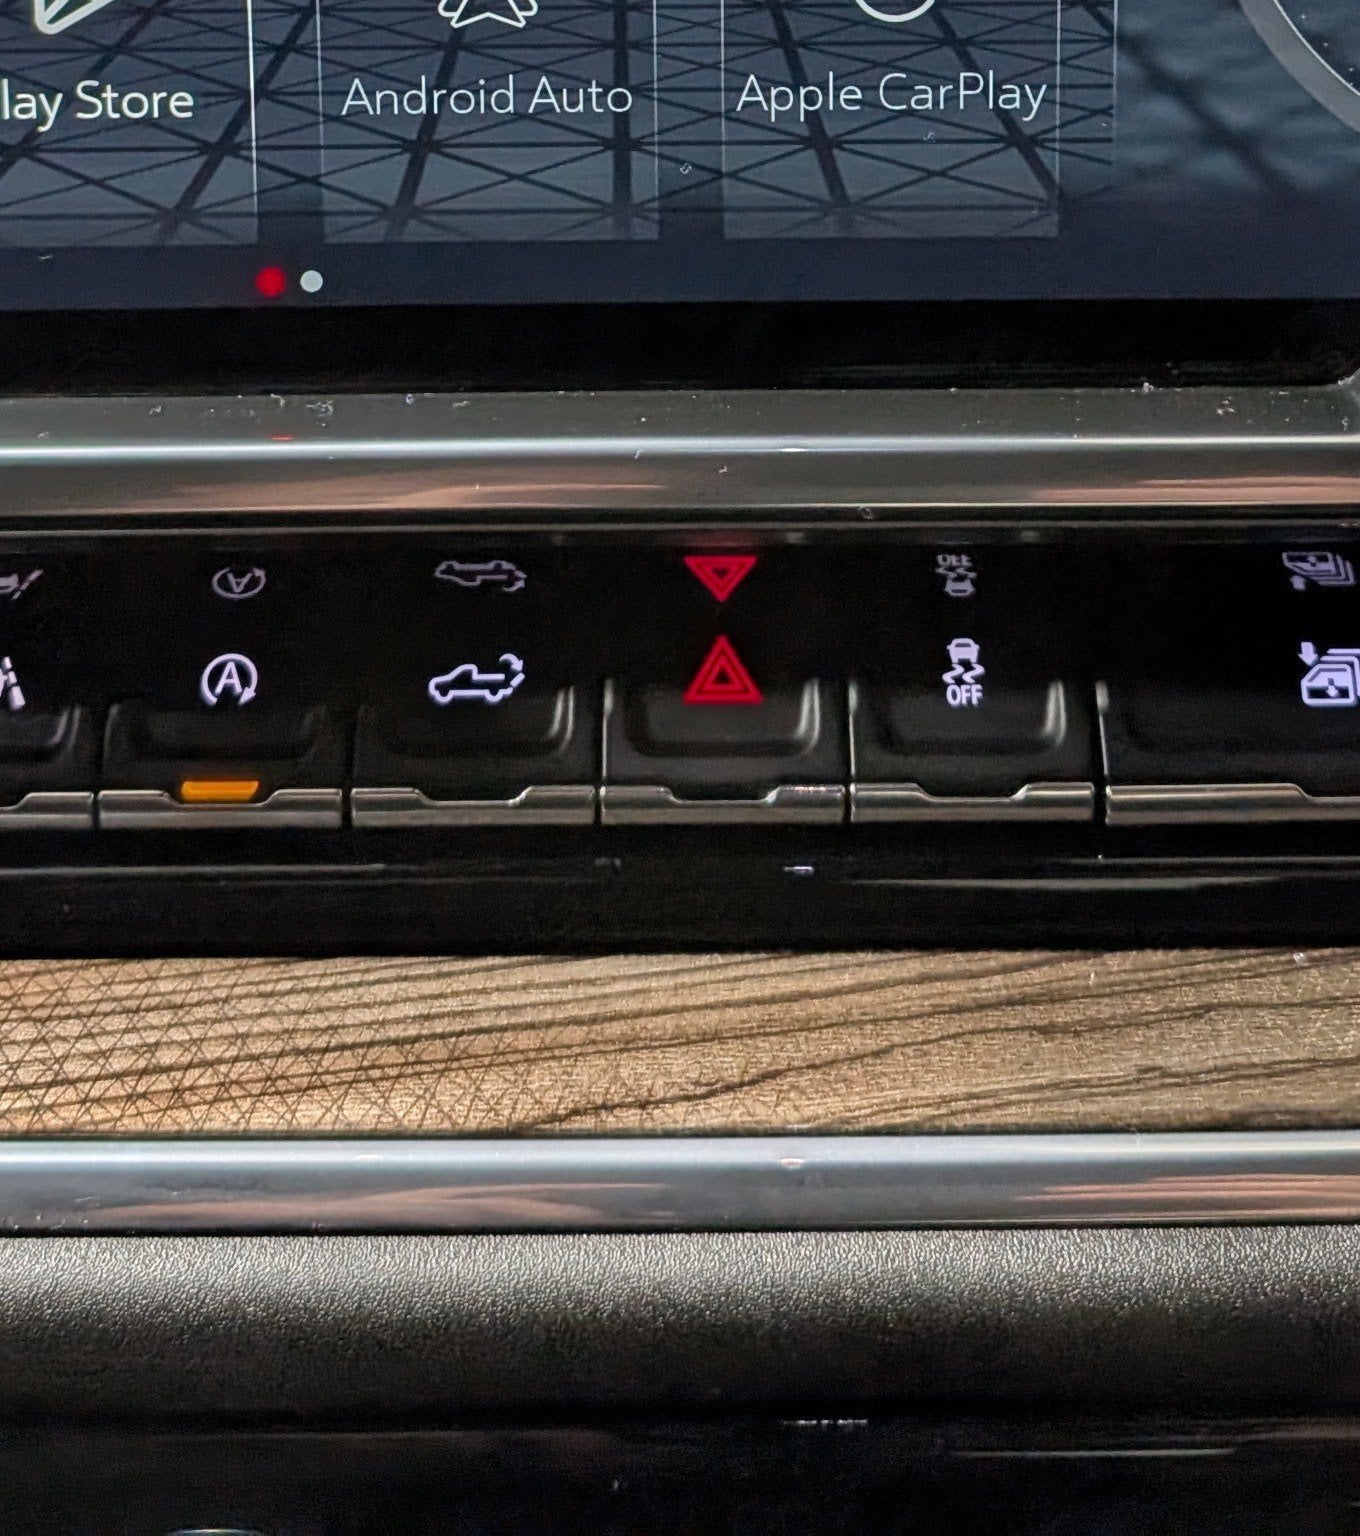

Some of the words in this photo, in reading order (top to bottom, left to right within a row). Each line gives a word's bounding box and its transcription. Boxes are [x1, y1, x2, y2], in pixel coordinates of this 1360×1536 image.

[76, 79, 194, 119] Store
[341, 73, 515, 116] Android
[528, 75, 633, 114] Auto
[736, 70, 863, 123] Apple
[879, 69, 1048, 122] CarPlay
[945, 683, 984, 707] OFF
